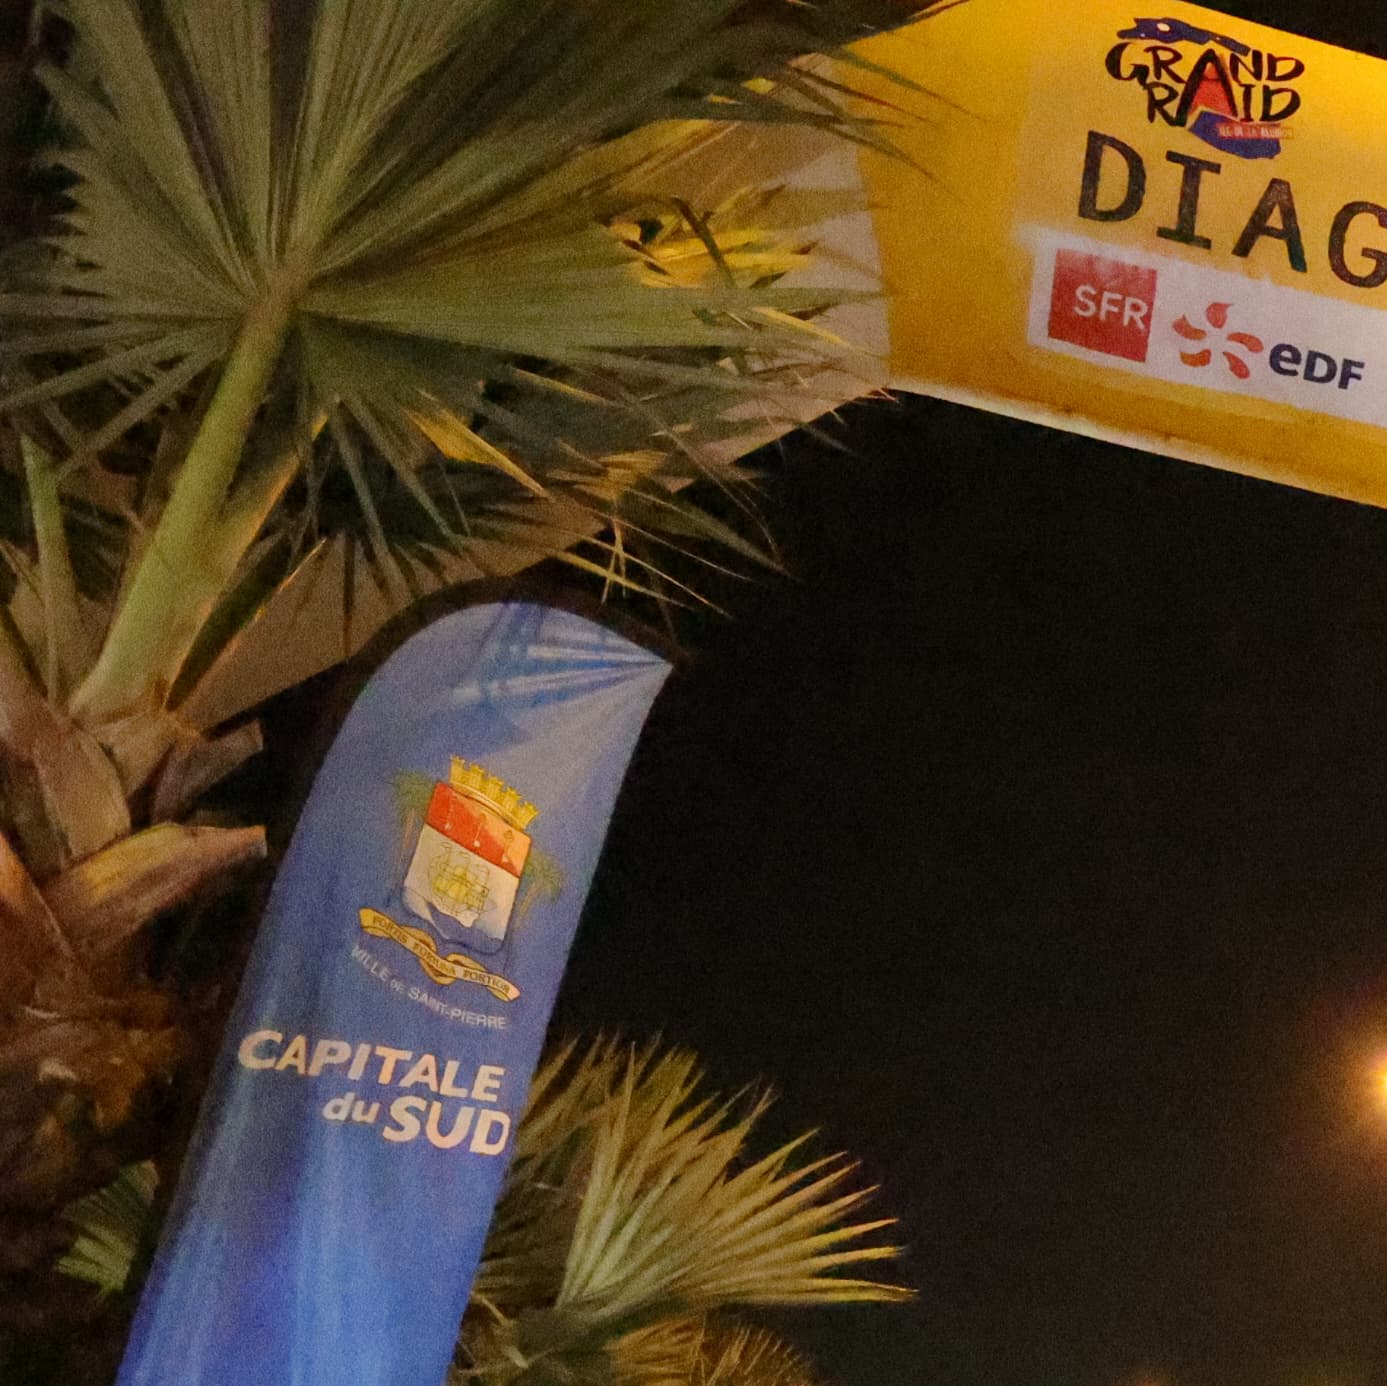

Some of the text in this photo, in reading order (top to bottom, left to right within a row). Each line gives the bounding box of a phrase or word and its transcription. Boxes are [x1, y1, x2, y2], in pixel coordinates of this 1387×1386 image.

[1105, 42, 1304, 90] GRAND
[1146, 80, 1301, 127] RAID
[1074, 283, 1149, 330] SFR
[352, 945, 391, 983] VILLE
[407, 986, 508, 1031] SAINT-PIERRE
[238, 1030, 505, 1103] CAPITALE
[322, 1089, 512, 1156] du SUD
